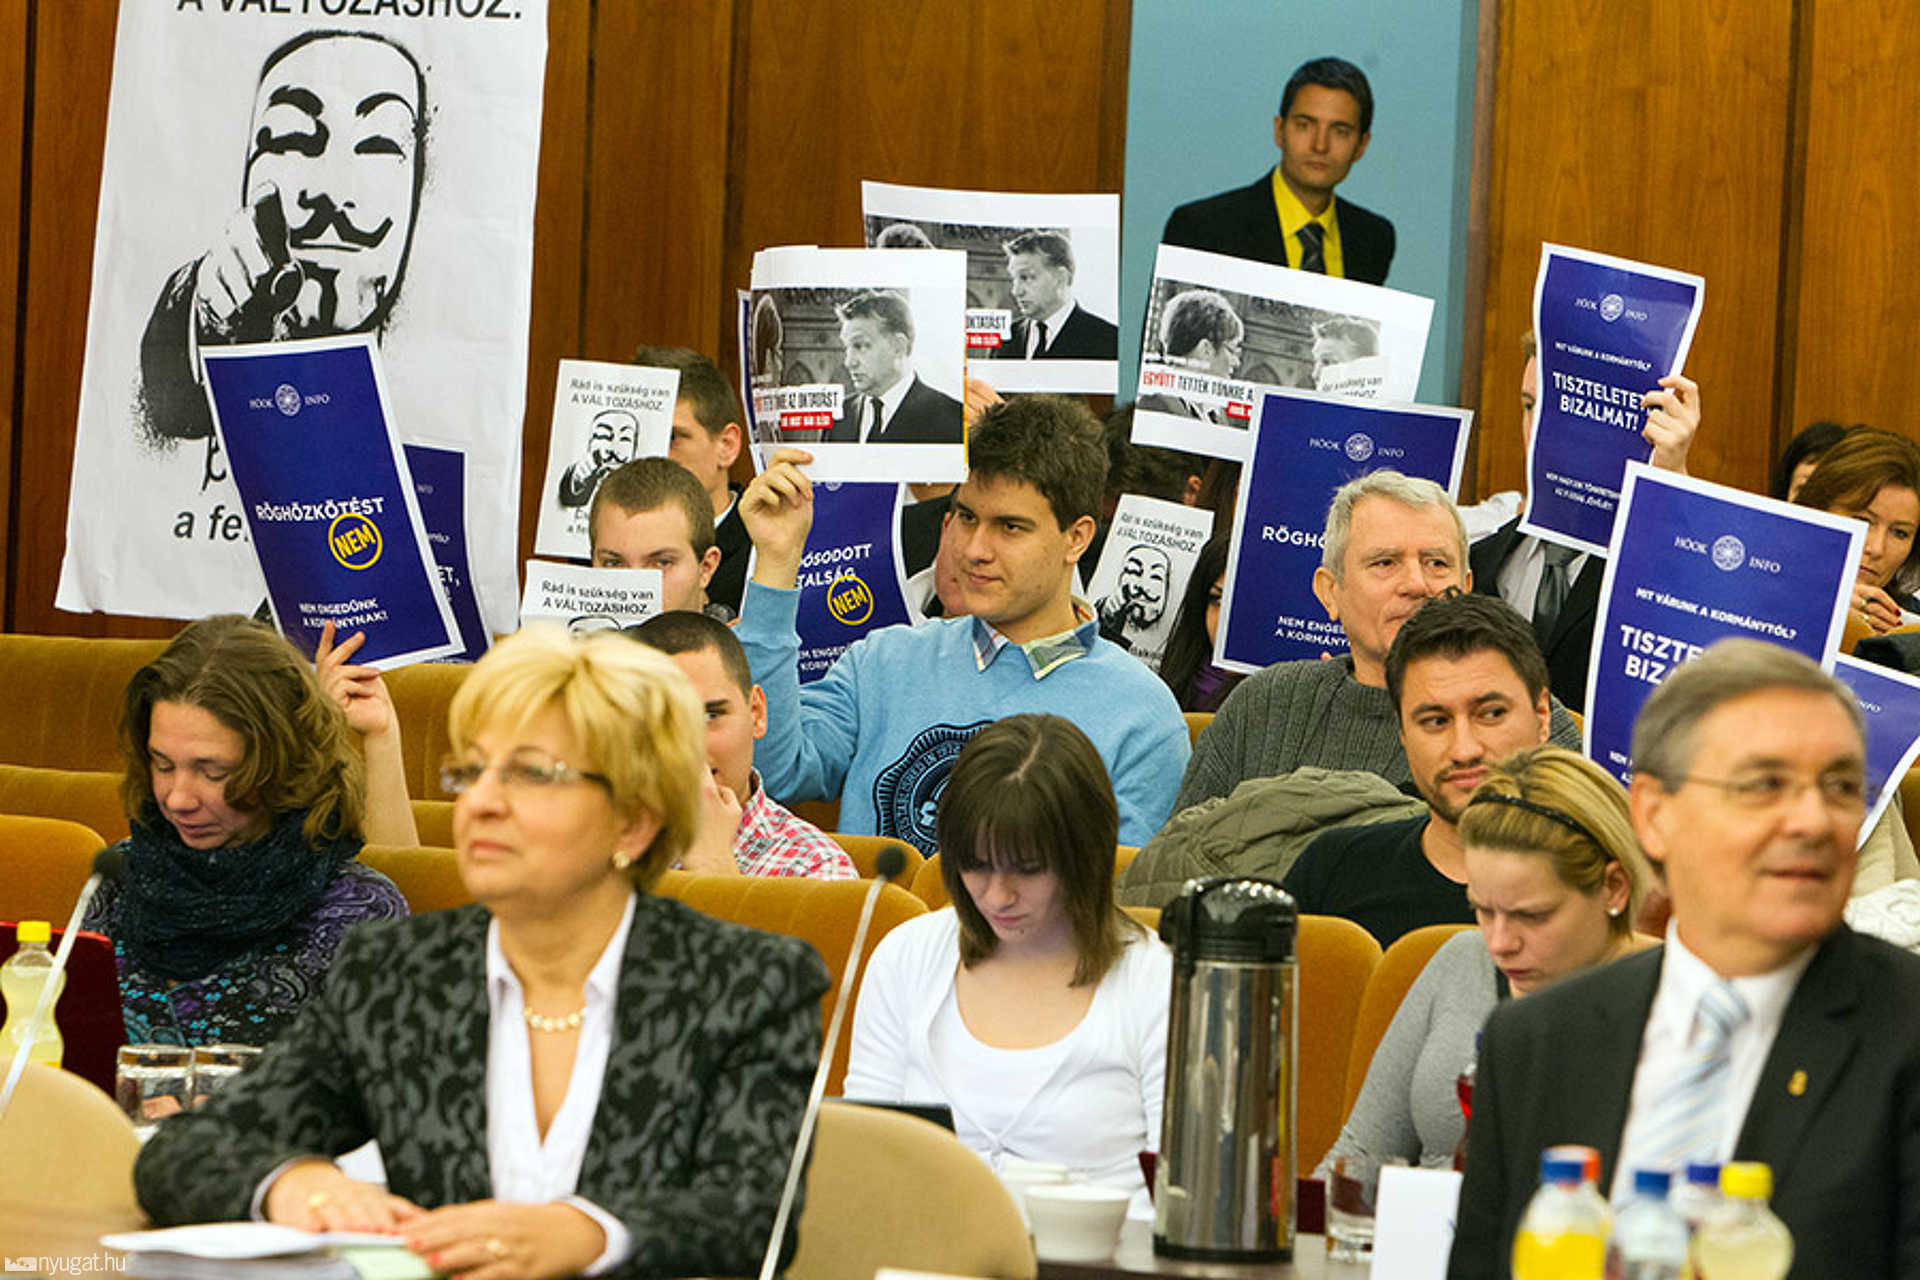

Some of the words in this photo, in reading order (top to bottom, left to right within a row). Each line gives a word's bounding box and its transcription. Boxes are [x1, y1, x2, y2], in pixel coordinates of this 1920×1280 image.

[1560, 394, 1639, 431] BIZALMAT!
[174, 512, 194, 538] a
[209, 504, 249, 541] fe
[334, 523, 377, 559] NEM
[800, 543, 872, 568] ÓSODOTT
[542, 580, 564, 593] Rád
[567, 583, 576, 595] is
[630, 590, 653, 600] van
[797, 565, 857, 589] TALSÁG
[543, 597, 551, 607] A
[833, 585, 869, 616] NEM
[1636, 587, 1655, 601] MIT
[1655, 593, 1700, 615] VÁRUNK
[1700, 606, 1709, 617] A
[1278, 615, 1305, 629] NEM
[1275, 628, 1284, 637] A
[1286, 629, 1352, 647] KORMÁNY
[1621, 624, 1705, 664] TISZTE
[1624, 654, 1674, 686] BIZ
